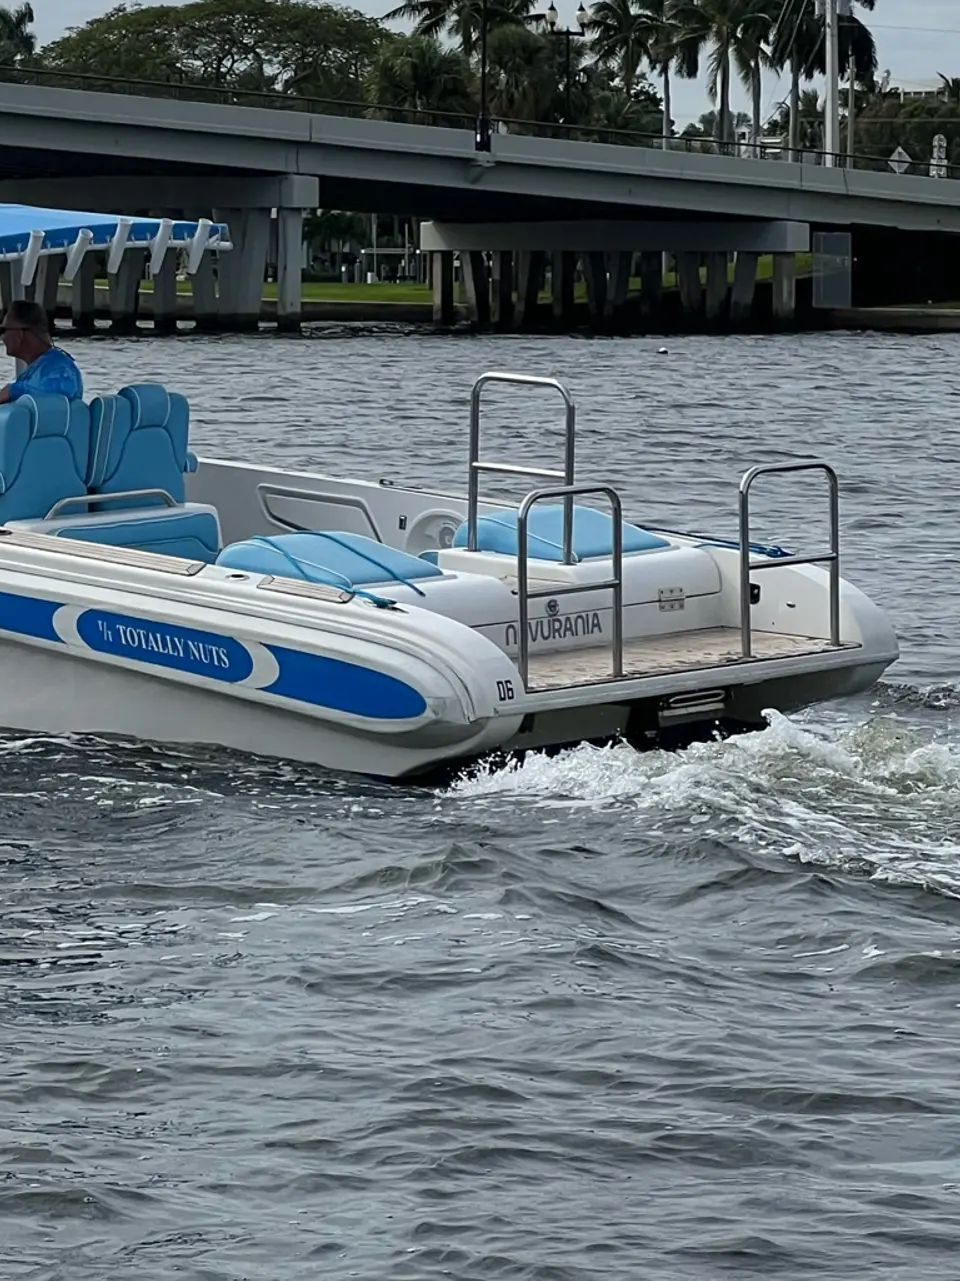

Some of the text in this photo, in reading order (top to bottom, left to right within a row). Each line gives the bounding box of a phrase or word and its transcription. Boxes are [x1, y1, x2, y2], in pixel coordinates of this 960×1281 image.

[116, 624, 184, 657] TOTALLY
[187, 639, 229, 668] NUTS
[505, 612, 602, 646] NVURANIA
